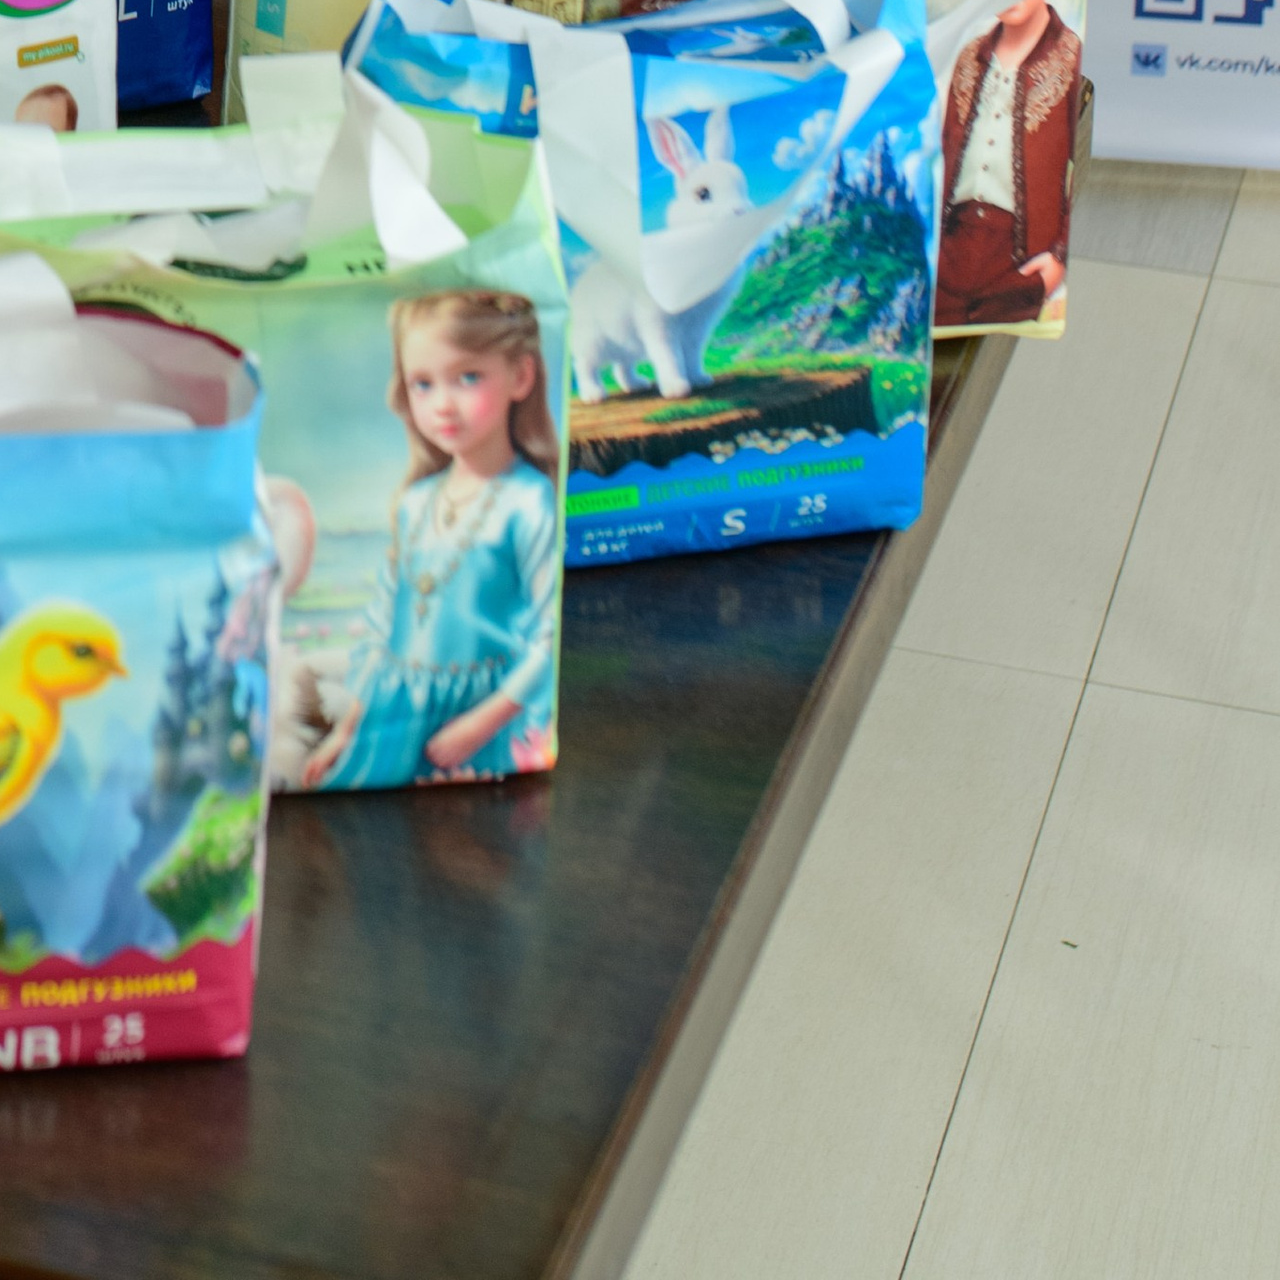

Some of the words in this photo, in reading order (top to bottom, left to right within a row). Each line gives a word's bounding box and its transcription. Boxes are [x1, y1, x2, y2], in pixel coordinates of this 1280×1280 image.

[1175, 51, 1280, 78] vk.com/k
[721, 507, 748, 537] S
[21, 968, 198, 1009] ПОДГУЗНИКИ
